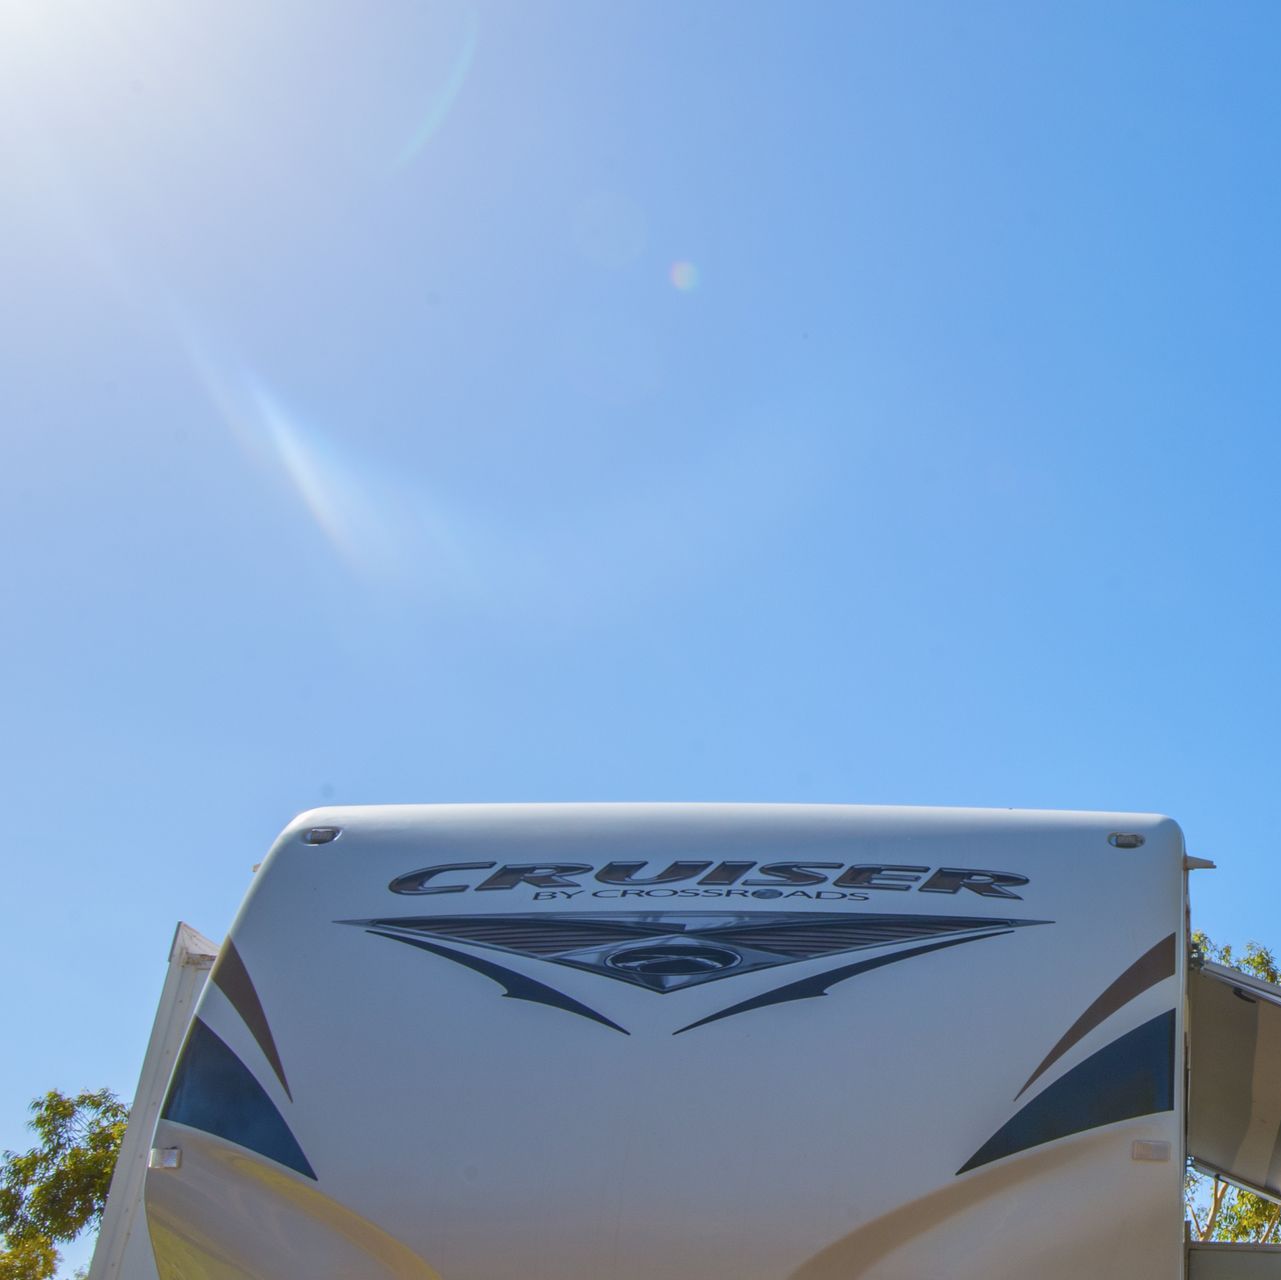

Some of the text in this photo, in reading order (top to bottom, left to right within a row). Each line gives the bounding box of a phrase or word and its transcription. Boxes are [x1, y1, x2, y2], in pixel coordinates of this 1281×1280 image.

[387, 860, 1031, 901] CRUISER
[532, 888, 870, 902] BY CROSSROADS
